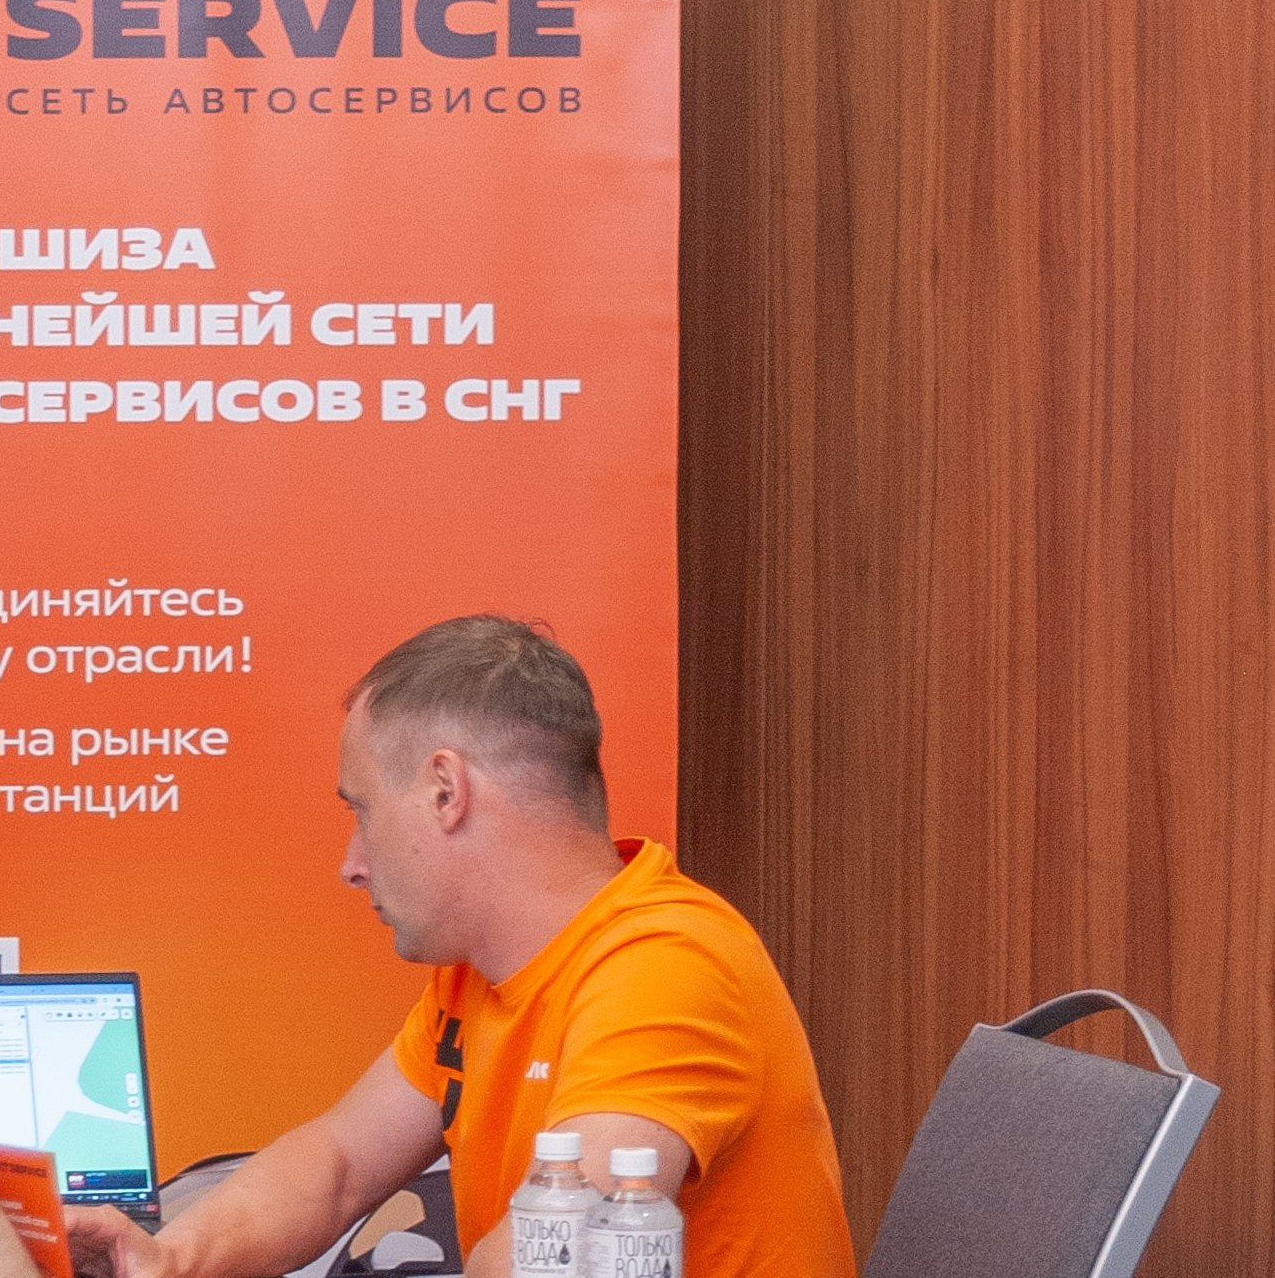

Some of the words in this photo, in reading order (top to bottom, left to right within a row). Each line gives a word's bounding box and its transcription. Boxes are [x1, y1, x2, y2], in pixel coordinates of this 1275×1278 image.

[6, 88, 128, 116] СЕТЬ
[163, 86, 583, 115] АВТОСЕРВИСОВ
[310, 302, 495, 347] СЕТИ
[380, 379, 427, 422] В
[444, 378, 582, 422] СНГ
[26, 636, 252, 683] отрасли!
[71, 727, 229, 766] рынке
[516, 1216, 572, 1242] ТОЛЬКО
[615, 1234, 673, 1258] ТОЛЬКО
[516, 1239, 560, 1266] ВОДА
